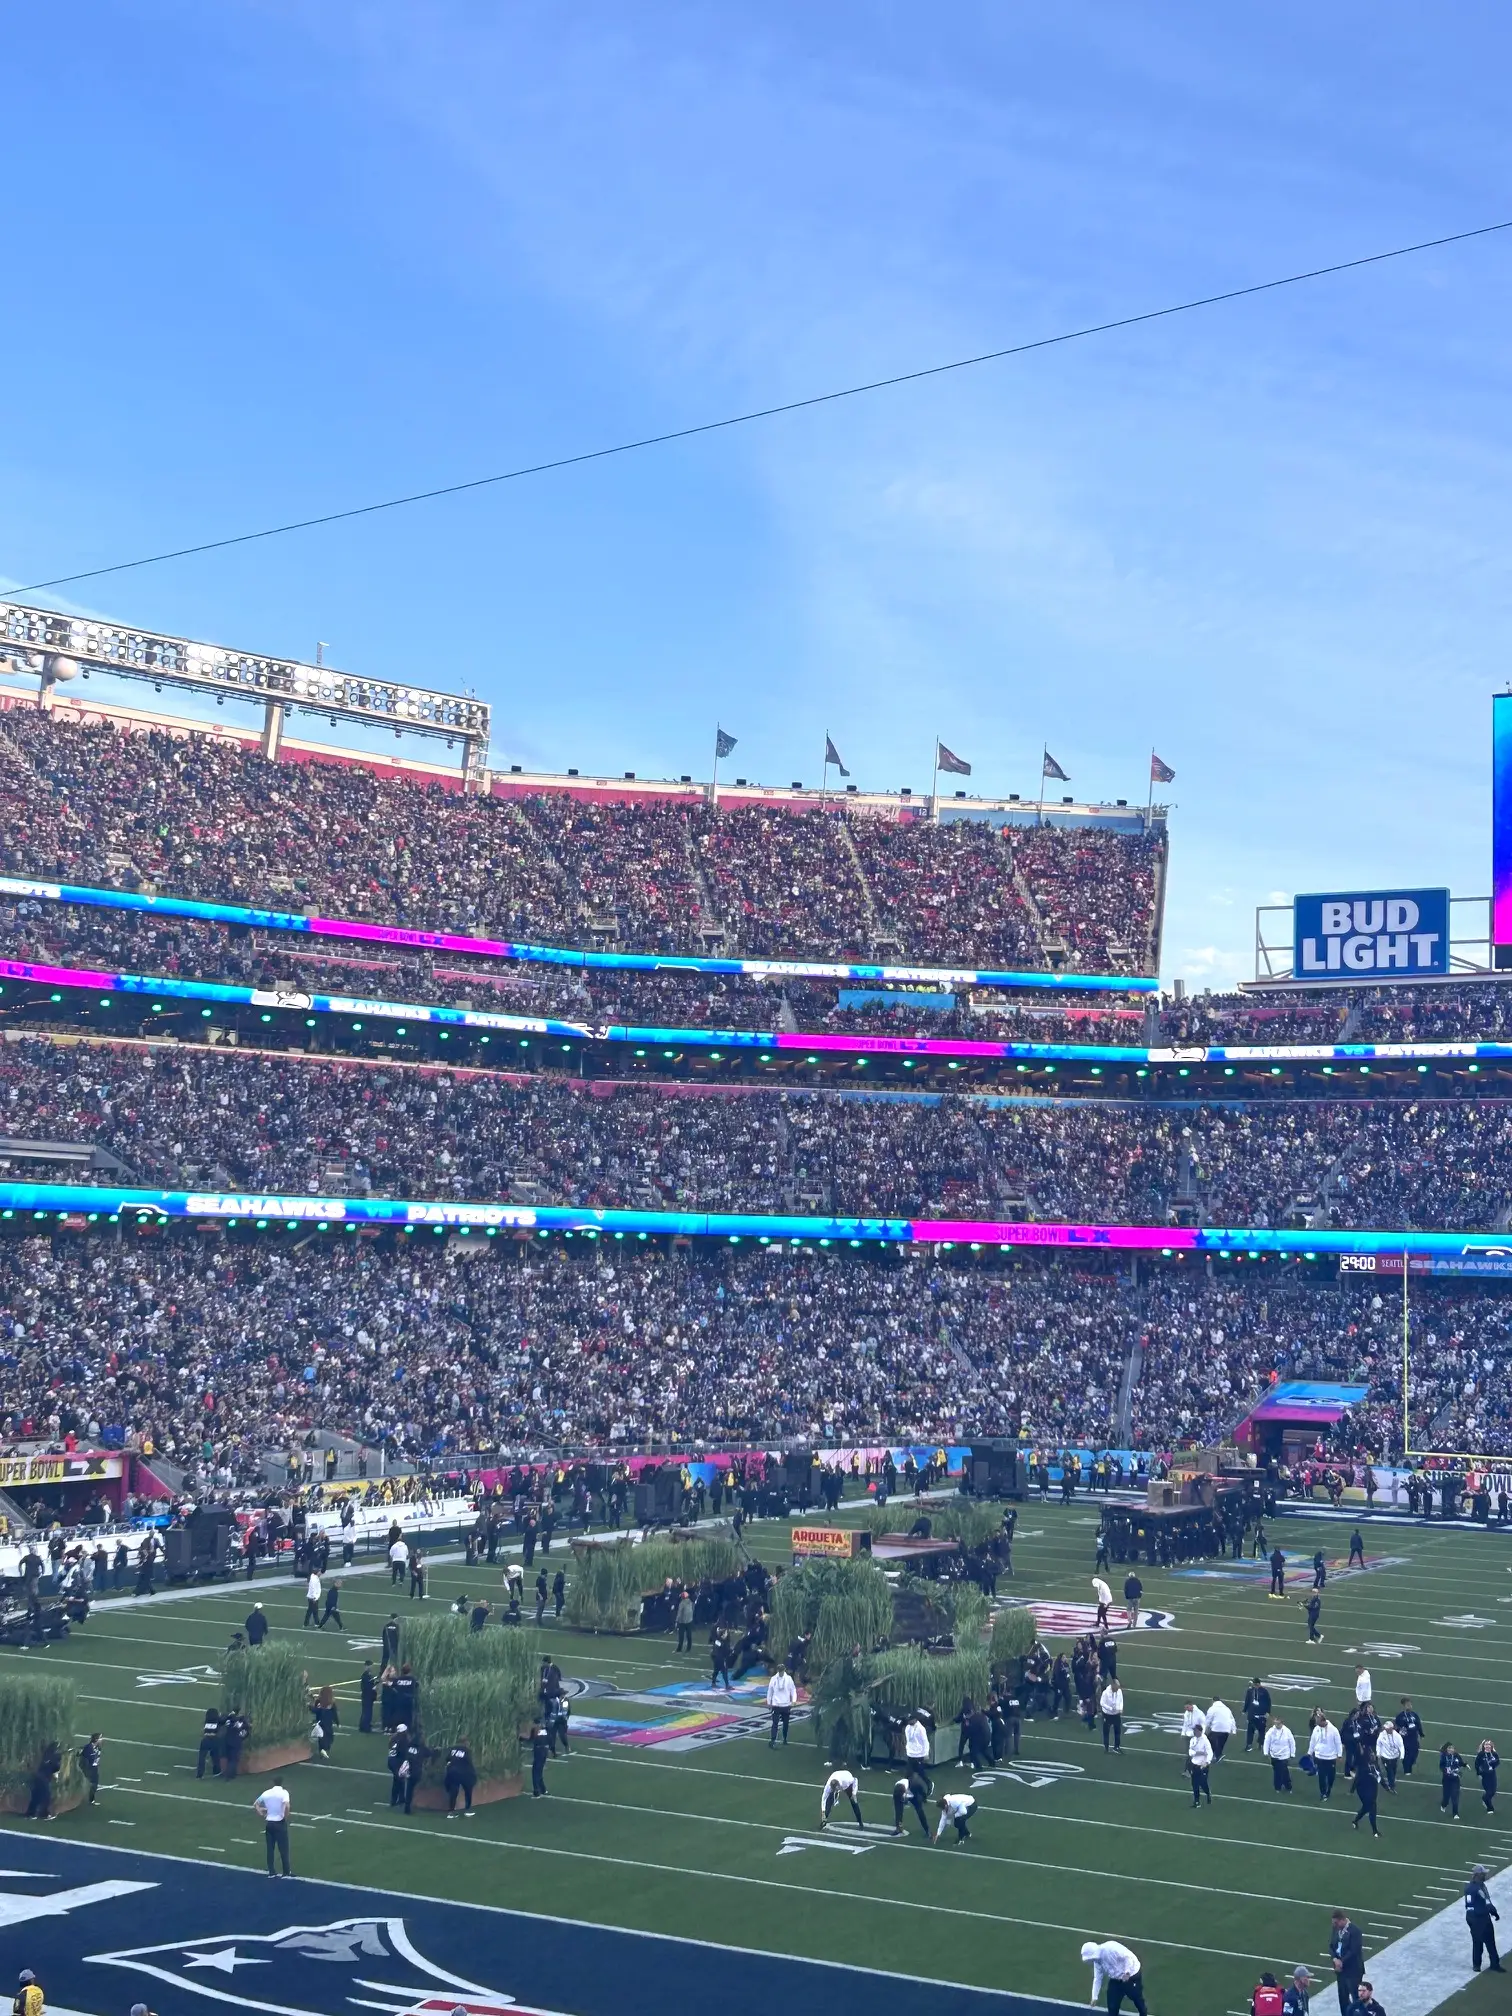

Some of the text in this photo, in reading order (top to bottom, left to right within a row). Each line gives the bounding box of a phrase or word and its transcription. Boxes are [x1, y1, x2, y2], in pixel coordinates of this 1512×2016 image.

[1322, 899, 1420, 935] BUD
[1303, 933, 1439, 970] LIGHT
[329, 1000, 431, 1020] SEAHAWKS
[465, 1013, 547, 1032] PATRIOTS
[1224, 1046, 1335, 1058] SEAHAWKS
[1374, 1044, 1477, 1056] PATRIOTS
[186, 1196, 346, 1218] SEAHAWKS
[407, 1206, 537, 1225] PATRIOTS
[995, 1225, 1112, 1243] SUPER BOWL LX
[1341, 1256, 1376, 1271] 29:00
[1410, 1259, 1512, 1271] SEAHAWKS
[30, 1459, 60, 1480] BOWL
[63, 1457, 106, 1477] LX
[969, 1760, 1085, 1788] 20
